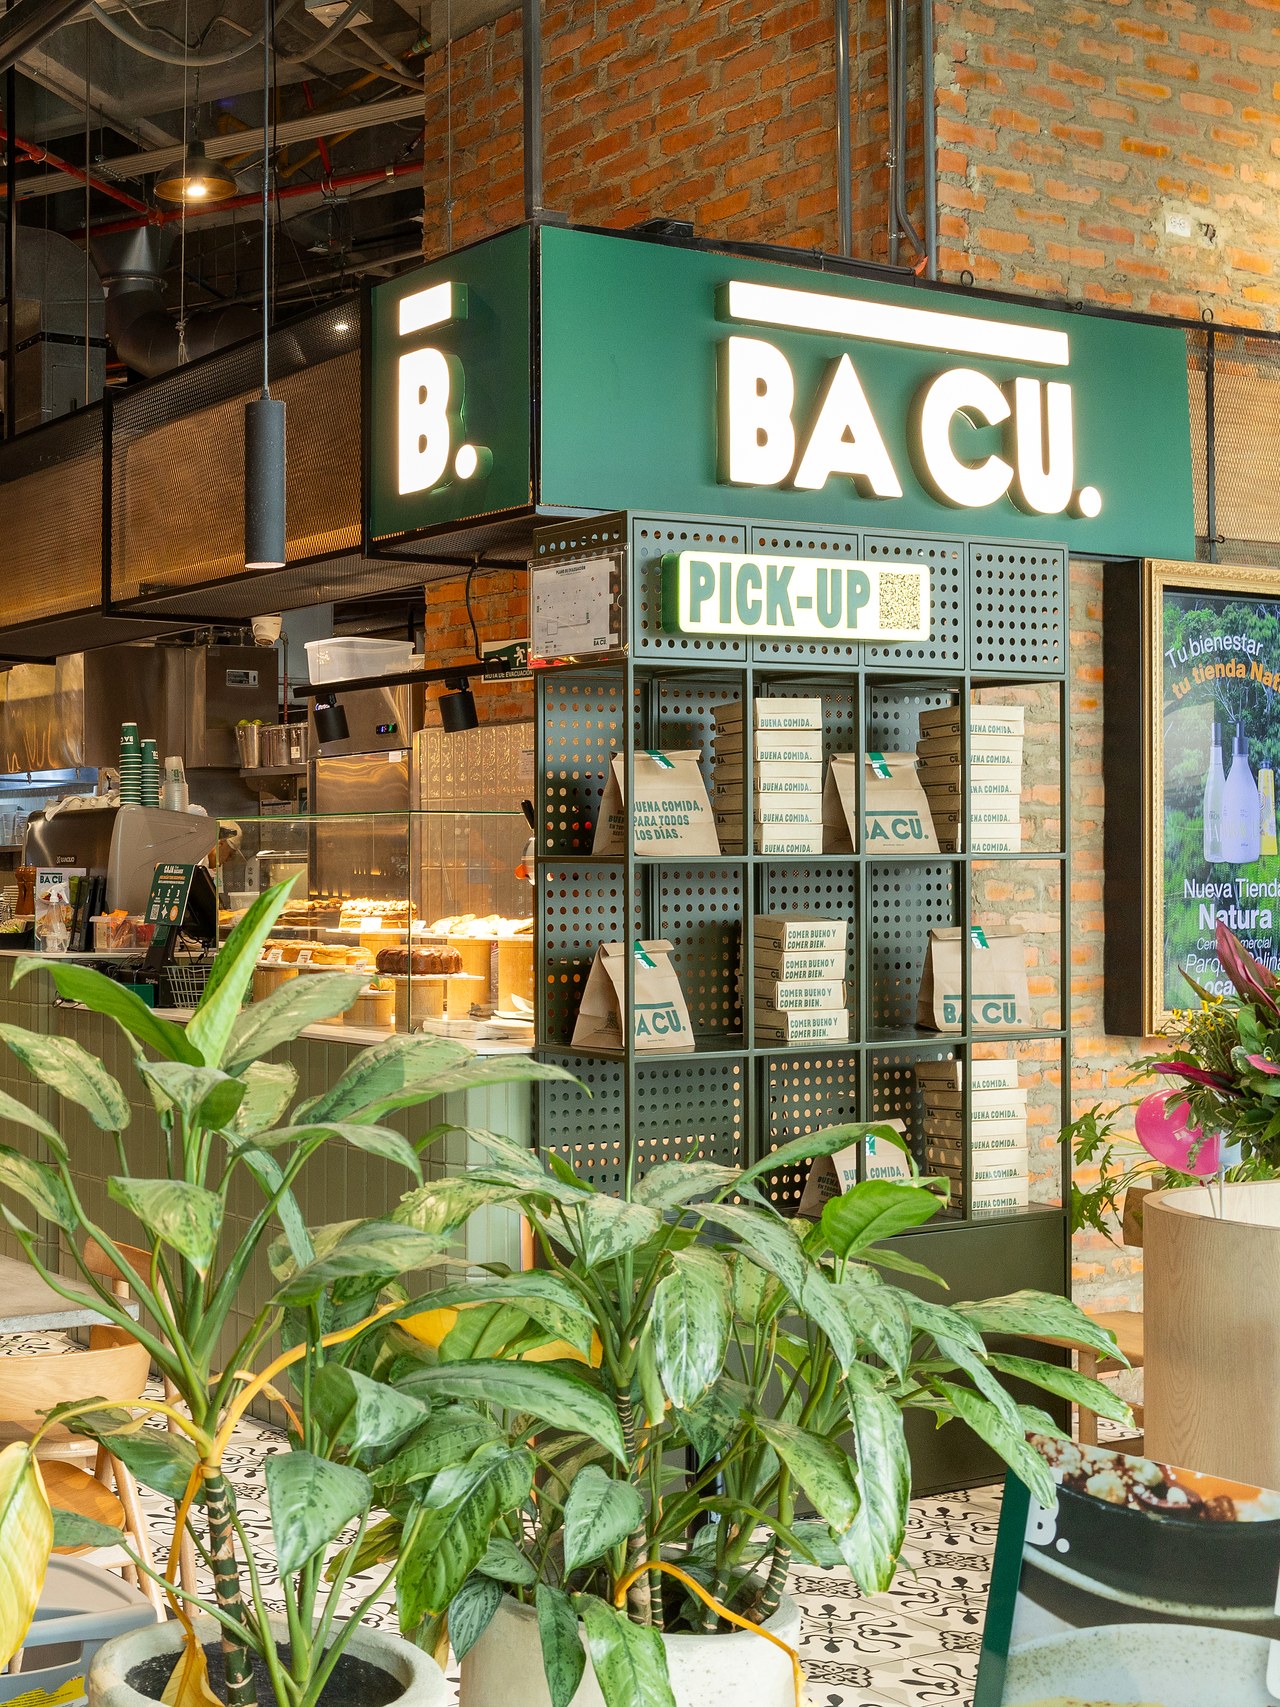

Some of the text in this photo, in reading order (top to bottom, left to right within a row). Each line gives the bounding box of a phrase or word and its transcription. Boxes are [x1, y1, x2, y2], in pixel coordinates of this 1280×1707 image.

[398, 347, 478, 496] B.
[689, 560, 871, 630] PICK-UP
[1164, 633, 1264, 669] Tu bienestar
[1172, 658, 1280, 700] tu tienda Nat
[760, 718, 813, 727] BUENA COMIDA.
[970, 724, 1015, 734] UENA COMIDA.
[760, 751, 813, 760] BUENA COMIDA.
[970, 754, 1013, 764] ENA COMIDA.
[762, 782, 783, 792] BUENA
[783, 782, 812, 792] COMIDA.
[970, 784, 1012, 794] ENA COMIDA.
[661, 799, 704, 813] COMIDA,
[633, 813, 690, 827] PARA TODOS
[763, 813, 784, 822] BUENA
[784, 813, 812, 822] COMIDA.
[970, 813, 1011, 822] ENA COMIDA.
[635, 825, 683, 841] LOS DÍAS.
[865, 818, 929, 840] A CU.
[764, 844, 785, 853] BUENA
[786, 844, 813, 853] COMIDA.
[982, 843, 1011, 852] COMIDA.
[39, 875, 50, 884] BA
[1183, 878, 1233, 899] Nueva
[787, 929, 837, 939] COMER BUENO Y
[787, 940, 826, 949] COMER BIEN.
[1240, 936, 1272, 949] mercial
[785, 958, 835, 969] COMER BUENO Y
[785, 970, 825, 979] COMER BIEN.
[780, 988, 832, 998] COMER BUENO Y
[780, 999, 822, 1008] COMER BIEN.
[982, 1002, 1023, 1024] CU.
[635, 1009, 687, 1037] A CU.
[790, 1017, 838, 1028] COMER BUENO Y
[790, 1029, 829, 1039] COMER BIEN.
[982, 1079, 1010, 1088] COMIDA.
[990, 1110, 1018, 1119] COMIDA.
[991, 1139, 1018, 1148] COMIDA.
[870, 1166, 904, 1179] COMIDA,
[975, 1169, 1020, 1180] BUENA COMIDA.
[972, 1200, 992, 1209] BUENA
[992, 1198, 1019, 1207] COMIDA.
